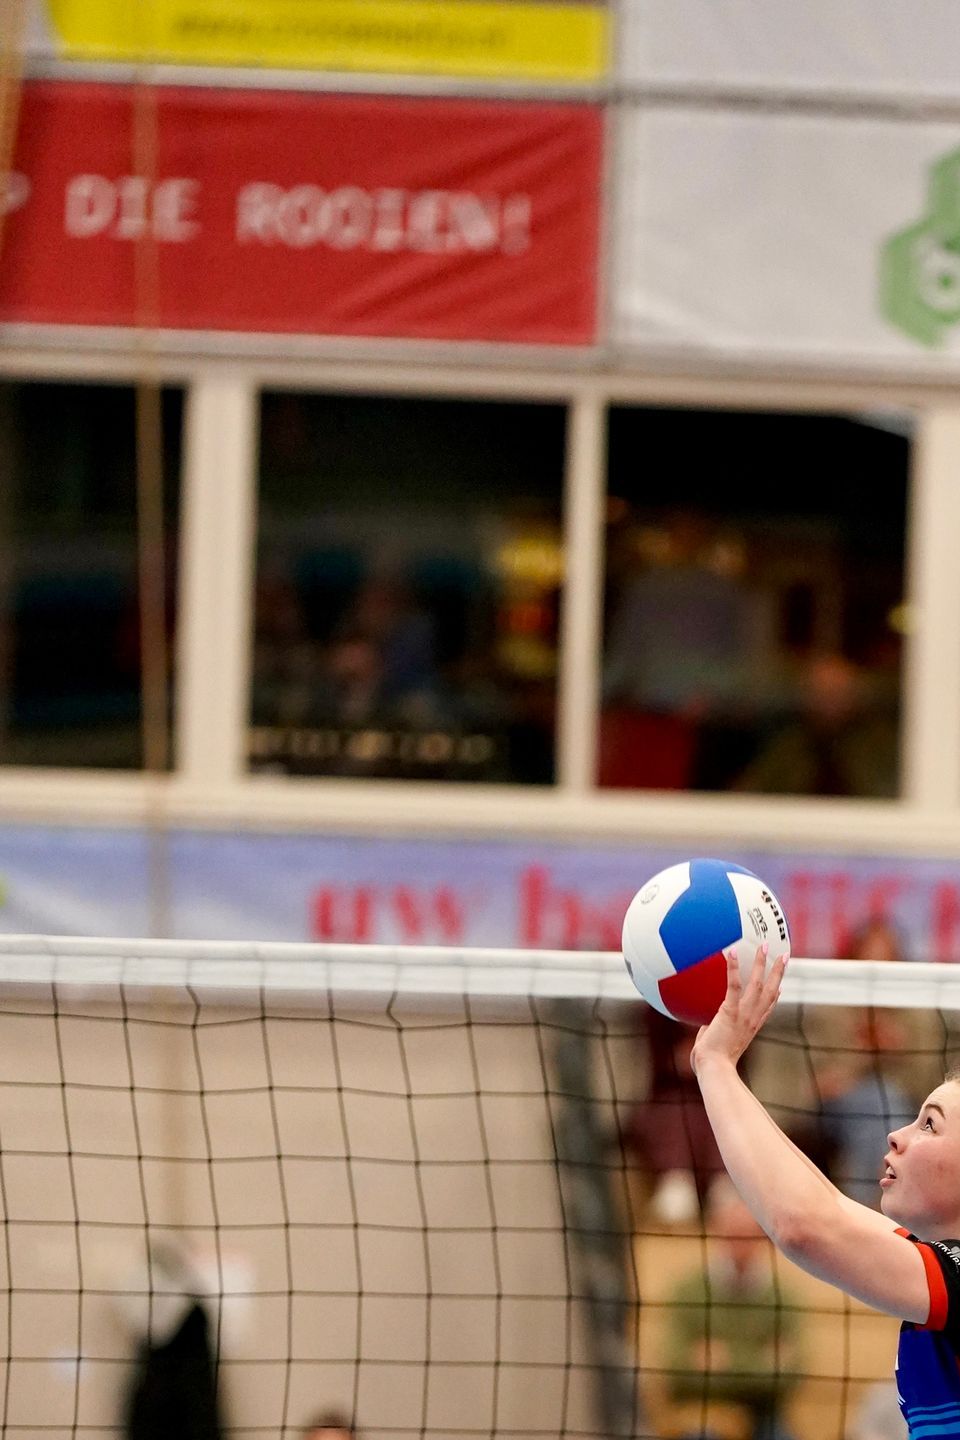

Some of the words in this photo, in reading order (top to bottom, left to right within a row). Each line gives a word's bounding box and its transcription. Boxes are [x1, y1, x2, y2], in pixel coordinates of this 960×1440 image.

[64, 173, 201, 243] DIE
[235, 181, 532, 256] ROOIEN!
[761, 890, 787, 941] gala
